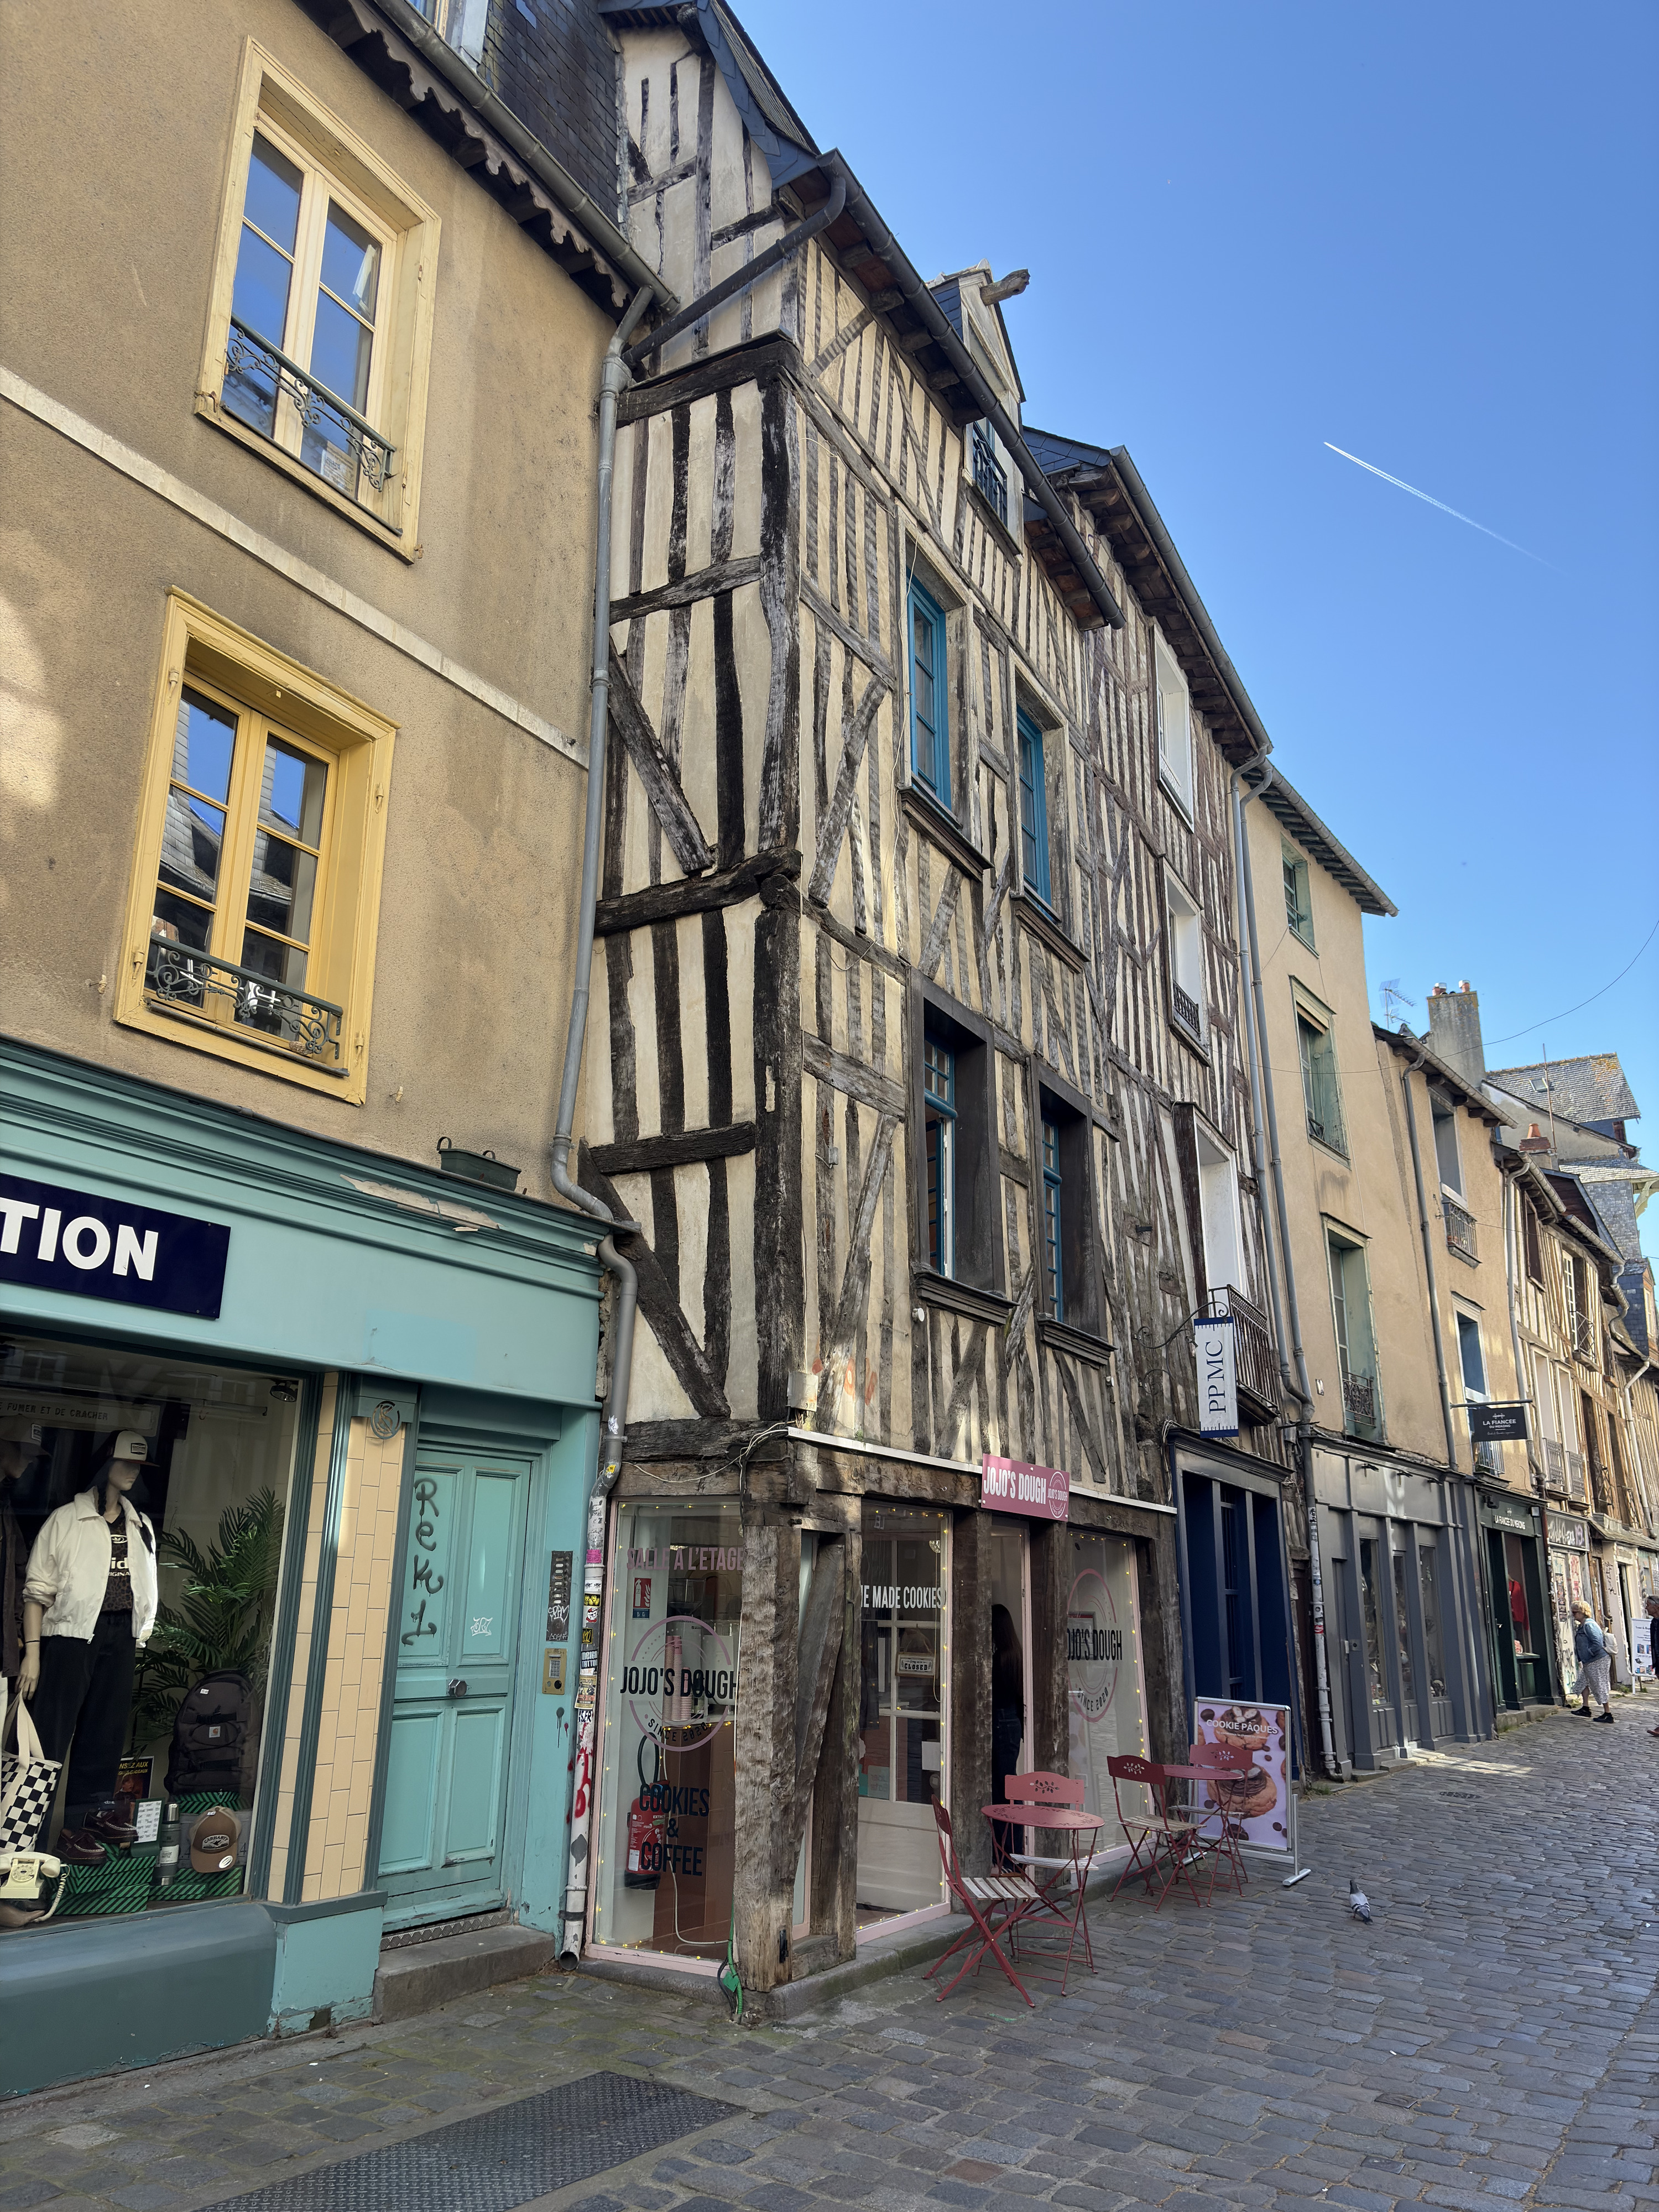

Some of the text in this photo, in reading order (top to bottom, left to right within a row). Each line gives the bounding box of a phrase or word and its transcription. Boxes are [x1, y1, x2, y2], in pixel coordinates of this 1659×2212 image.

[0, 1198, 159, 1281] TION
[1204, 1340, 1227, 1414] PPMC
[7, 1402, 36, 1413] FUMER
[40, 1406, 51, 1415] ET
[55, 1407, 66, 1416] DE
[70, 1409, 108, 1421] CRACHER
[983, 1466, 1047, 1505] JOJO'S DOUGH
[627, 1547, 670, 1571] SALLE
[872, 1585, 901, 1609] MADE
[903, 1587, 942, 1609] COOKIES
[1093, 1629, 1123, 1661] DOUGH
[620, 1666, 740, 1699] JOJO'S DOUGH
[1096, 1687, 1109, 1710] 2020
[648, 1718, 708, 1741] SINCE 2020
[1206, 1719, 1240, 1730] COOKIE
[1241, 1721, 1279, 1735] PÂQUES
[639, 1783, 710, 1817] COOKIES
[666, 1818, 679, 1838] &
[641, 1841, 703, 1876] COFFEE
